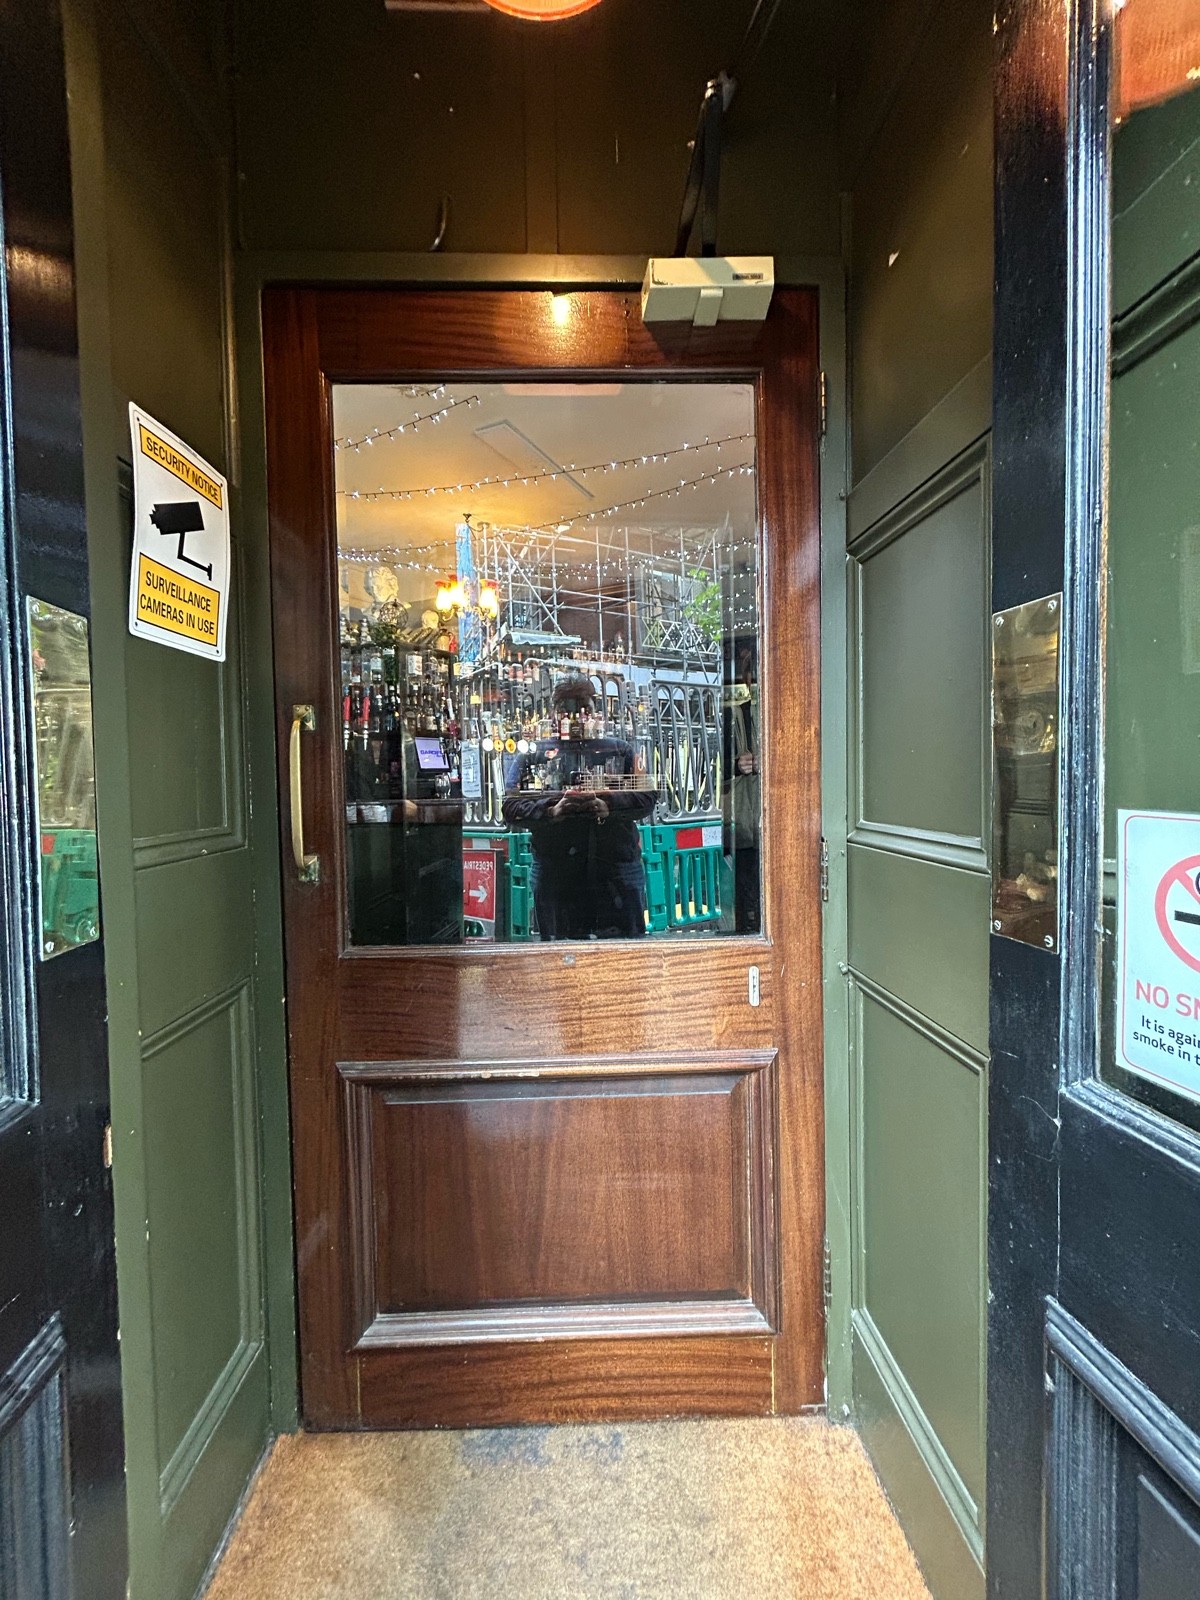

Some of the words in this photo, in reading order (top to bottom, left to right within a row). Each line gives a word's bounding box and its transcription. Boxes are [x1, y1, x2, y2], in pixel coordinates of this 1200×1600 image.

[146, 436, 190, 479] SECURITY
[192, 470, 219, 501] NOTICE
[145, 570, 211, 613] SURVEILLANCE
[140, 593, 184, 624] CAMERAS
[186, 612, 196, 629] IN
[197, 616, 215, 635] USE
[1135, 979, 1170, 1009] NO
[1141, 1015, 1152, 1030] It
[1154, 1019, 1165, 1034] is
[1133, 1031, 1175, 1055] smoke
[1178, 1046, 1191, 1062] in
